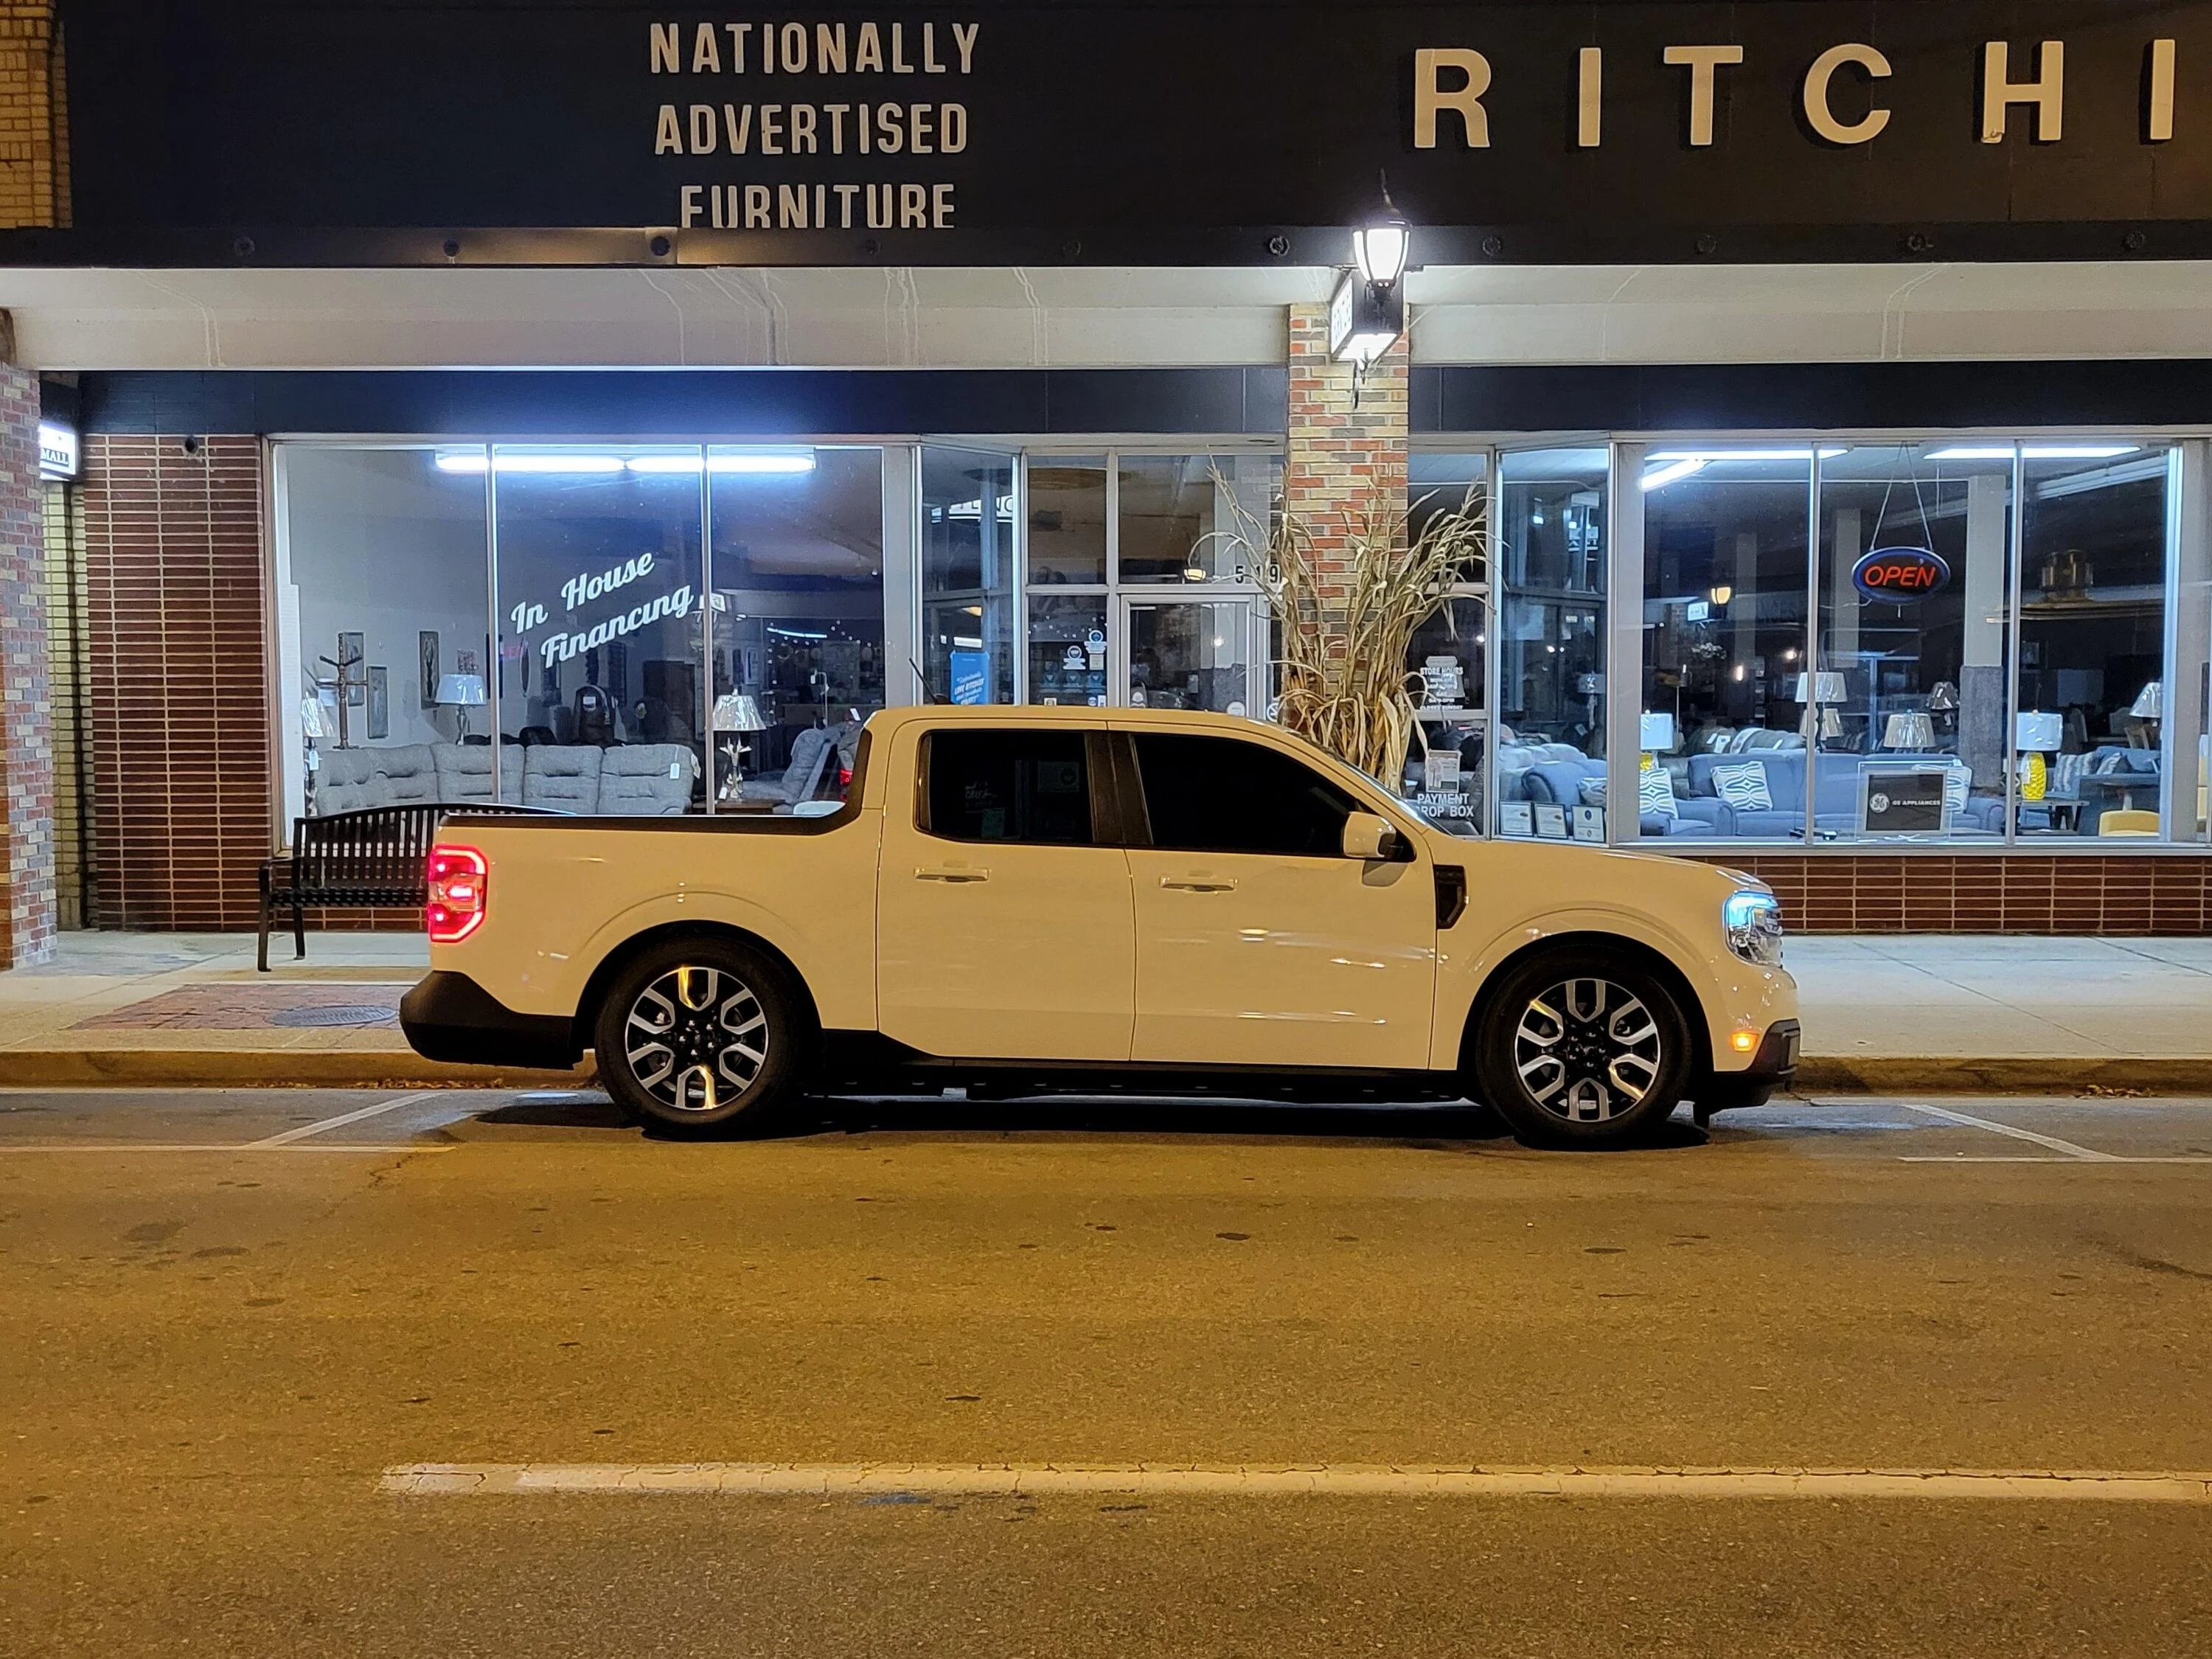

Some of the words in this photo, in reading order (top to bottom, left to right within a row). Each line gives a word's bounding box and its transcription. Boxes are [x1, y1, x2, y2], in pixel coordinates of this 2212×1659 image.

[650, 22, 979, 74] NATIONALLY
[1414, 39, 2176, 148] RITCHI
[655, 102, 967, 155] ADVERTISED
[681, 184, 955, 229] FURNITURE
[511, 601, 549, 634] In
[561, 553, 655, 611] House
[1865, 566, 1935, 587] OPEN
[540, 585, 694, 669] Financing
[1420, 667, 1441, 675] STORE
[1441, 667, 1464, 675] HOURS
[1416, 806, 1444, 818] ROP
[1450, 805, 1474, 818] BOX
[1417, 793, 1470, 804] PAYMENT
